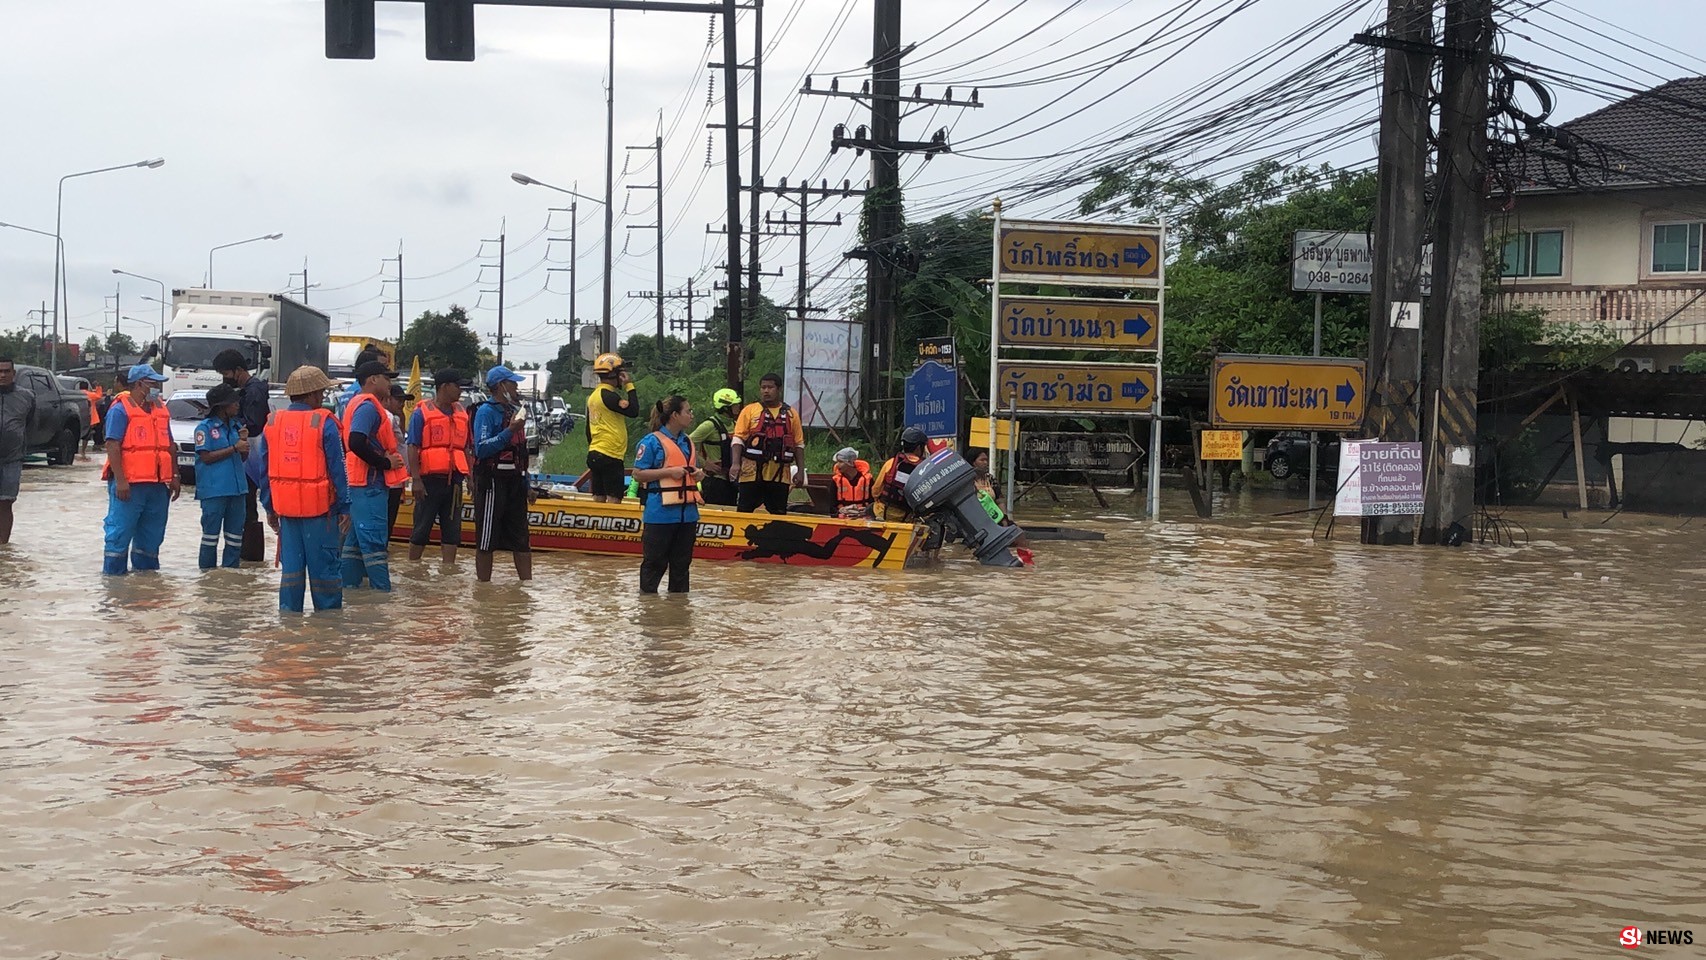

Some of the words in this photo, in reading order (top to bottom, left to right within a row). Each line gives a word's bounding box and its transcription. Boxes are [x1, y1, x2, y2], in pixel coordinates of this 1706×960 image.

[1008, 237, 1119, 268] วัดโพธิ์ทอง
[1301, 242, 1332, 262] บริษัท
[1336, 247, 1375, 268] บูรพาแ
[1007, 308, 1116, 339] วัดบ้านนา
[914, 393, 945, 416] โพธิ์ทอง
[1225, 376, 1329, 410] วัดเขาชะเมา
[1329, 411, 1339, 420] 19
[1361, 444, 1421, 460] ขายที่ดิน
[1382, 462, 1422, 473] (ติดคลอง)
